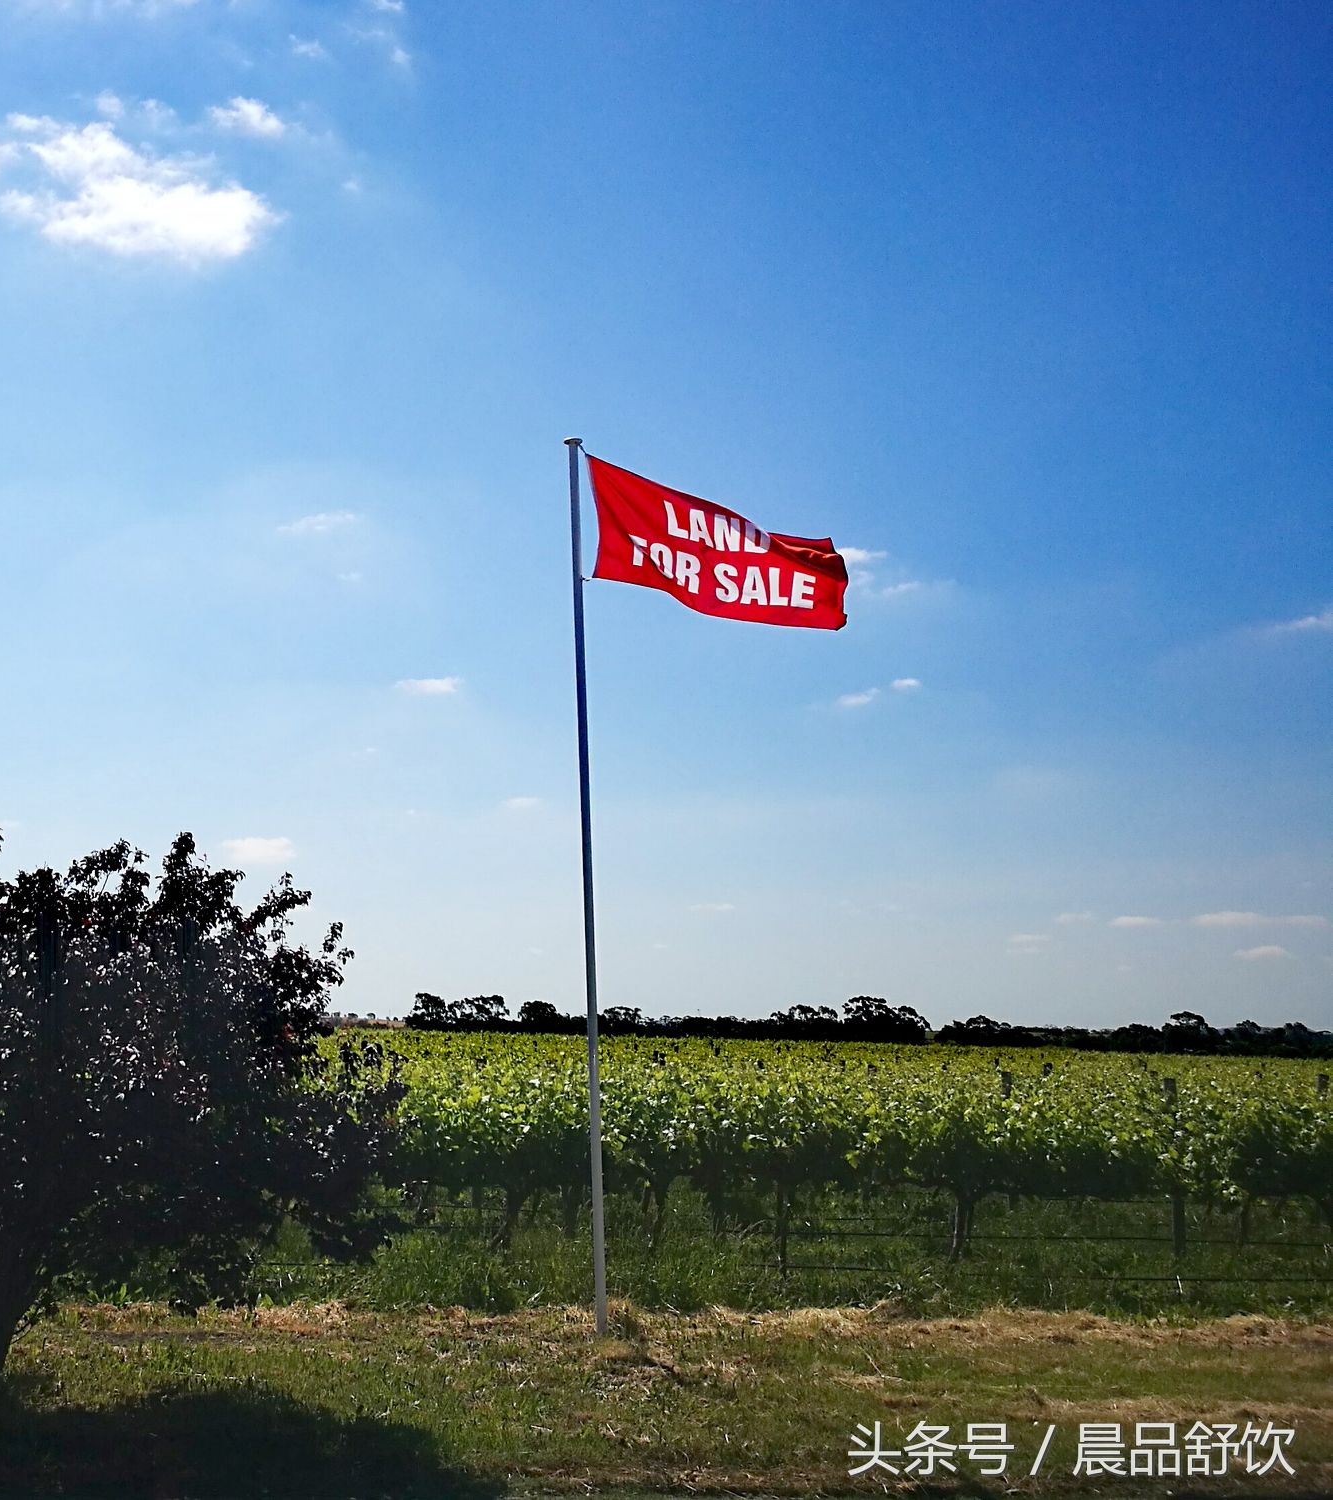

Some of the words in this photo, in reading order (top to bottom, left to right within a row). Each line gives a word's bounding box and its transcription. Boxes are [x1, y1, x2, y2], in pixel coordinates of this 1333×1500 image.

[663, 500, 771, 554] LAND
[629, 534, 701, 594] FOR
[714, 563, 816, 610] SALE
